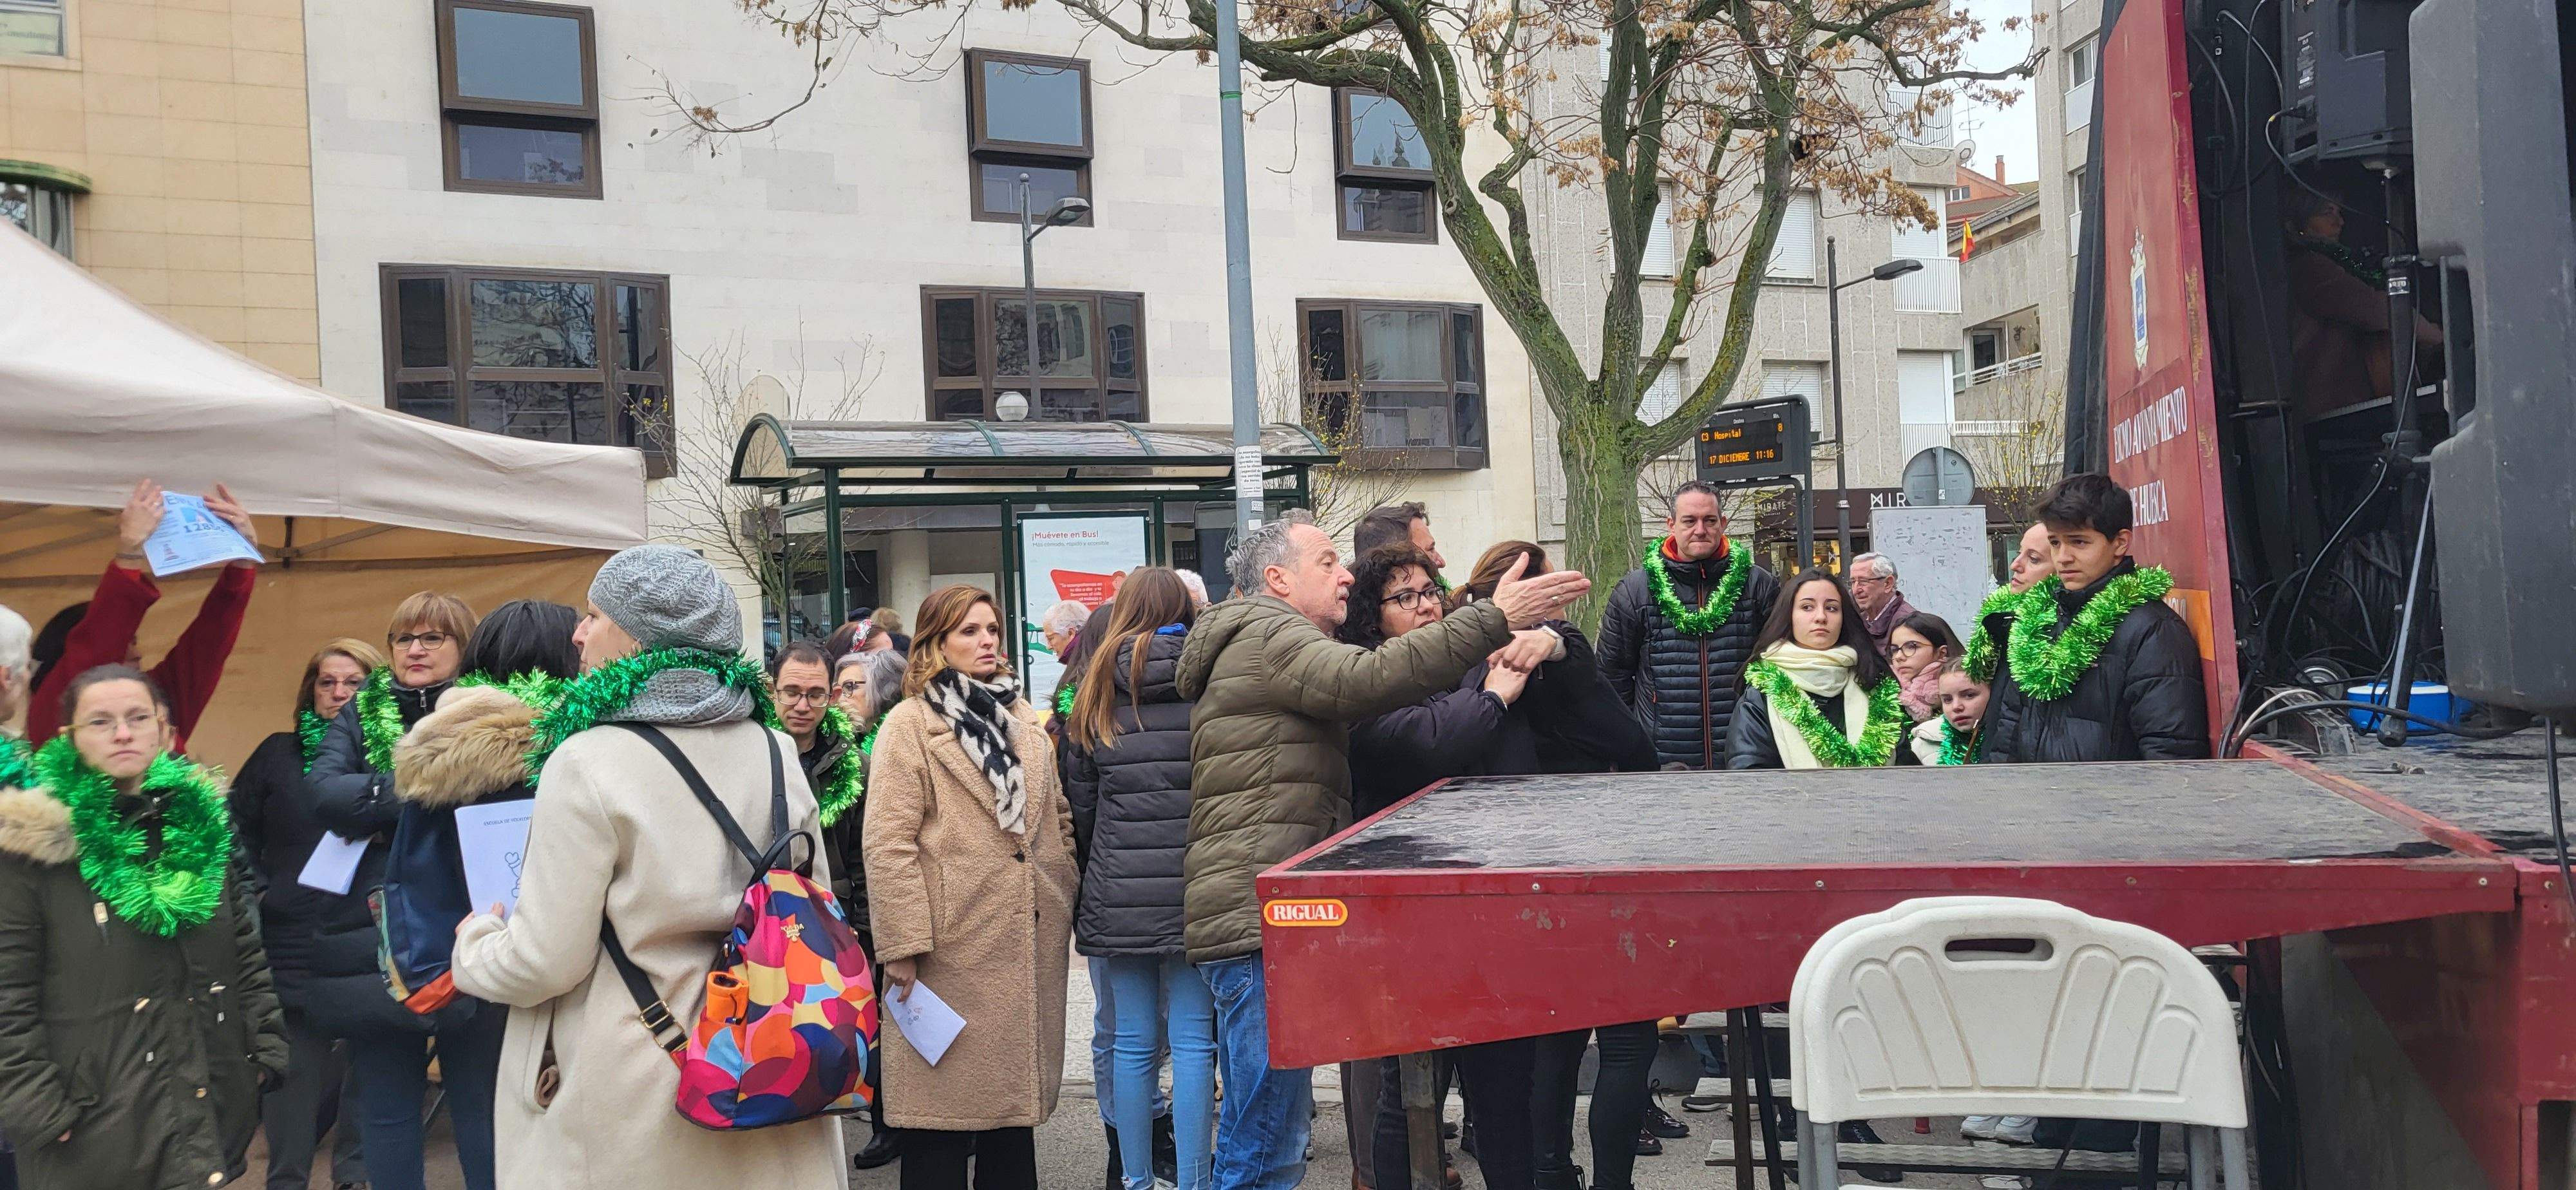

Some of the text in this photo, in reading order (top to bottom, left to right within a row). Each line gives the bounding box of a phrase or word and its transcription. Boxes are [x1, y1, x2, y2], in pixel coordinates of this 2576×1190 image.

[2132, 386, 2188, 456] AYUNTAMIENTO
[1701, 422, 1783, 442] C3 Hospital 8
[1709, 449, 1774, 464] 17 DICIEMBRE 11:16
[2139, 478, 2169, 526] HUESCA
[1032, 531, 1068, 541] ¡Muévete
[1273, 904, 1339, 921] RIGUAL
